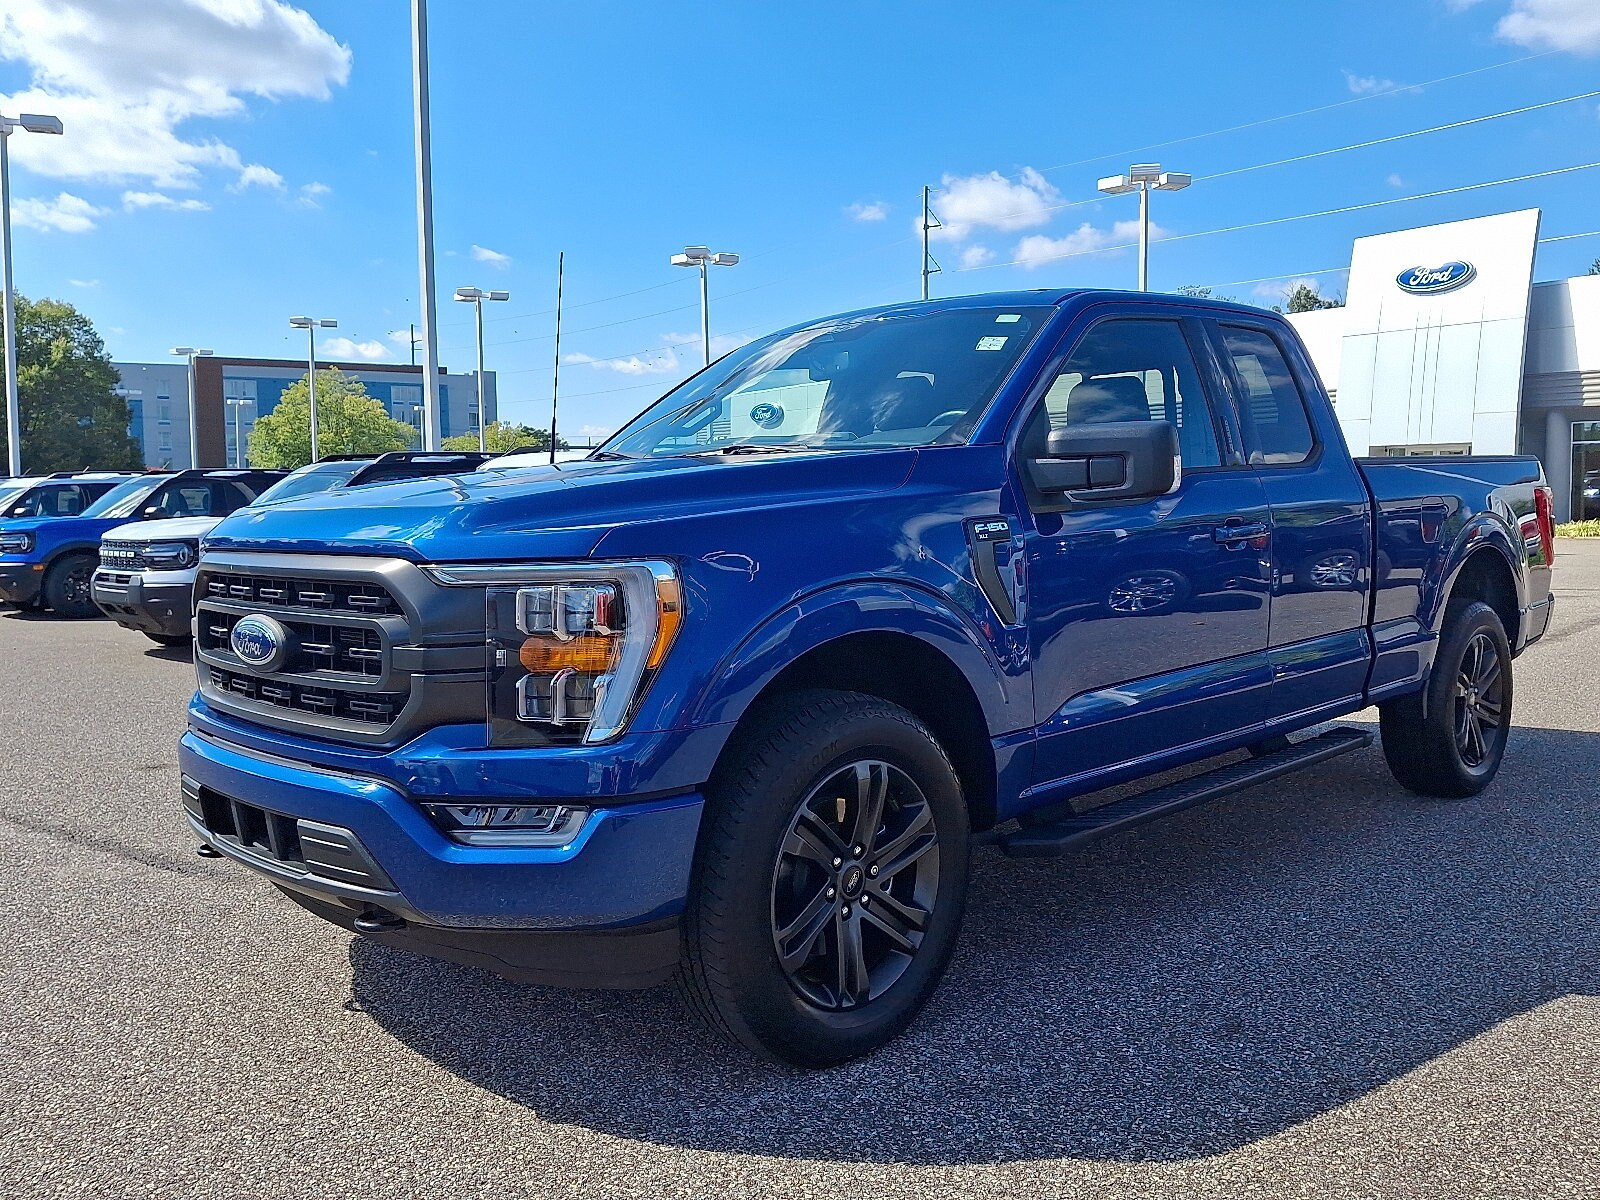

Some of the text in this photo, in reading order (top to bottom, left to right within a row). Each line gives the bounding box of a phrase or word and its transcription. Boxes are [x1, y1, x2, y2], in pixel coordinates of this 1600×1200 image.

[1409, 267, 1453, 285] Ford
[974, 522, 1009, 533] F-150
[238, 629, 263, 656] Ford
